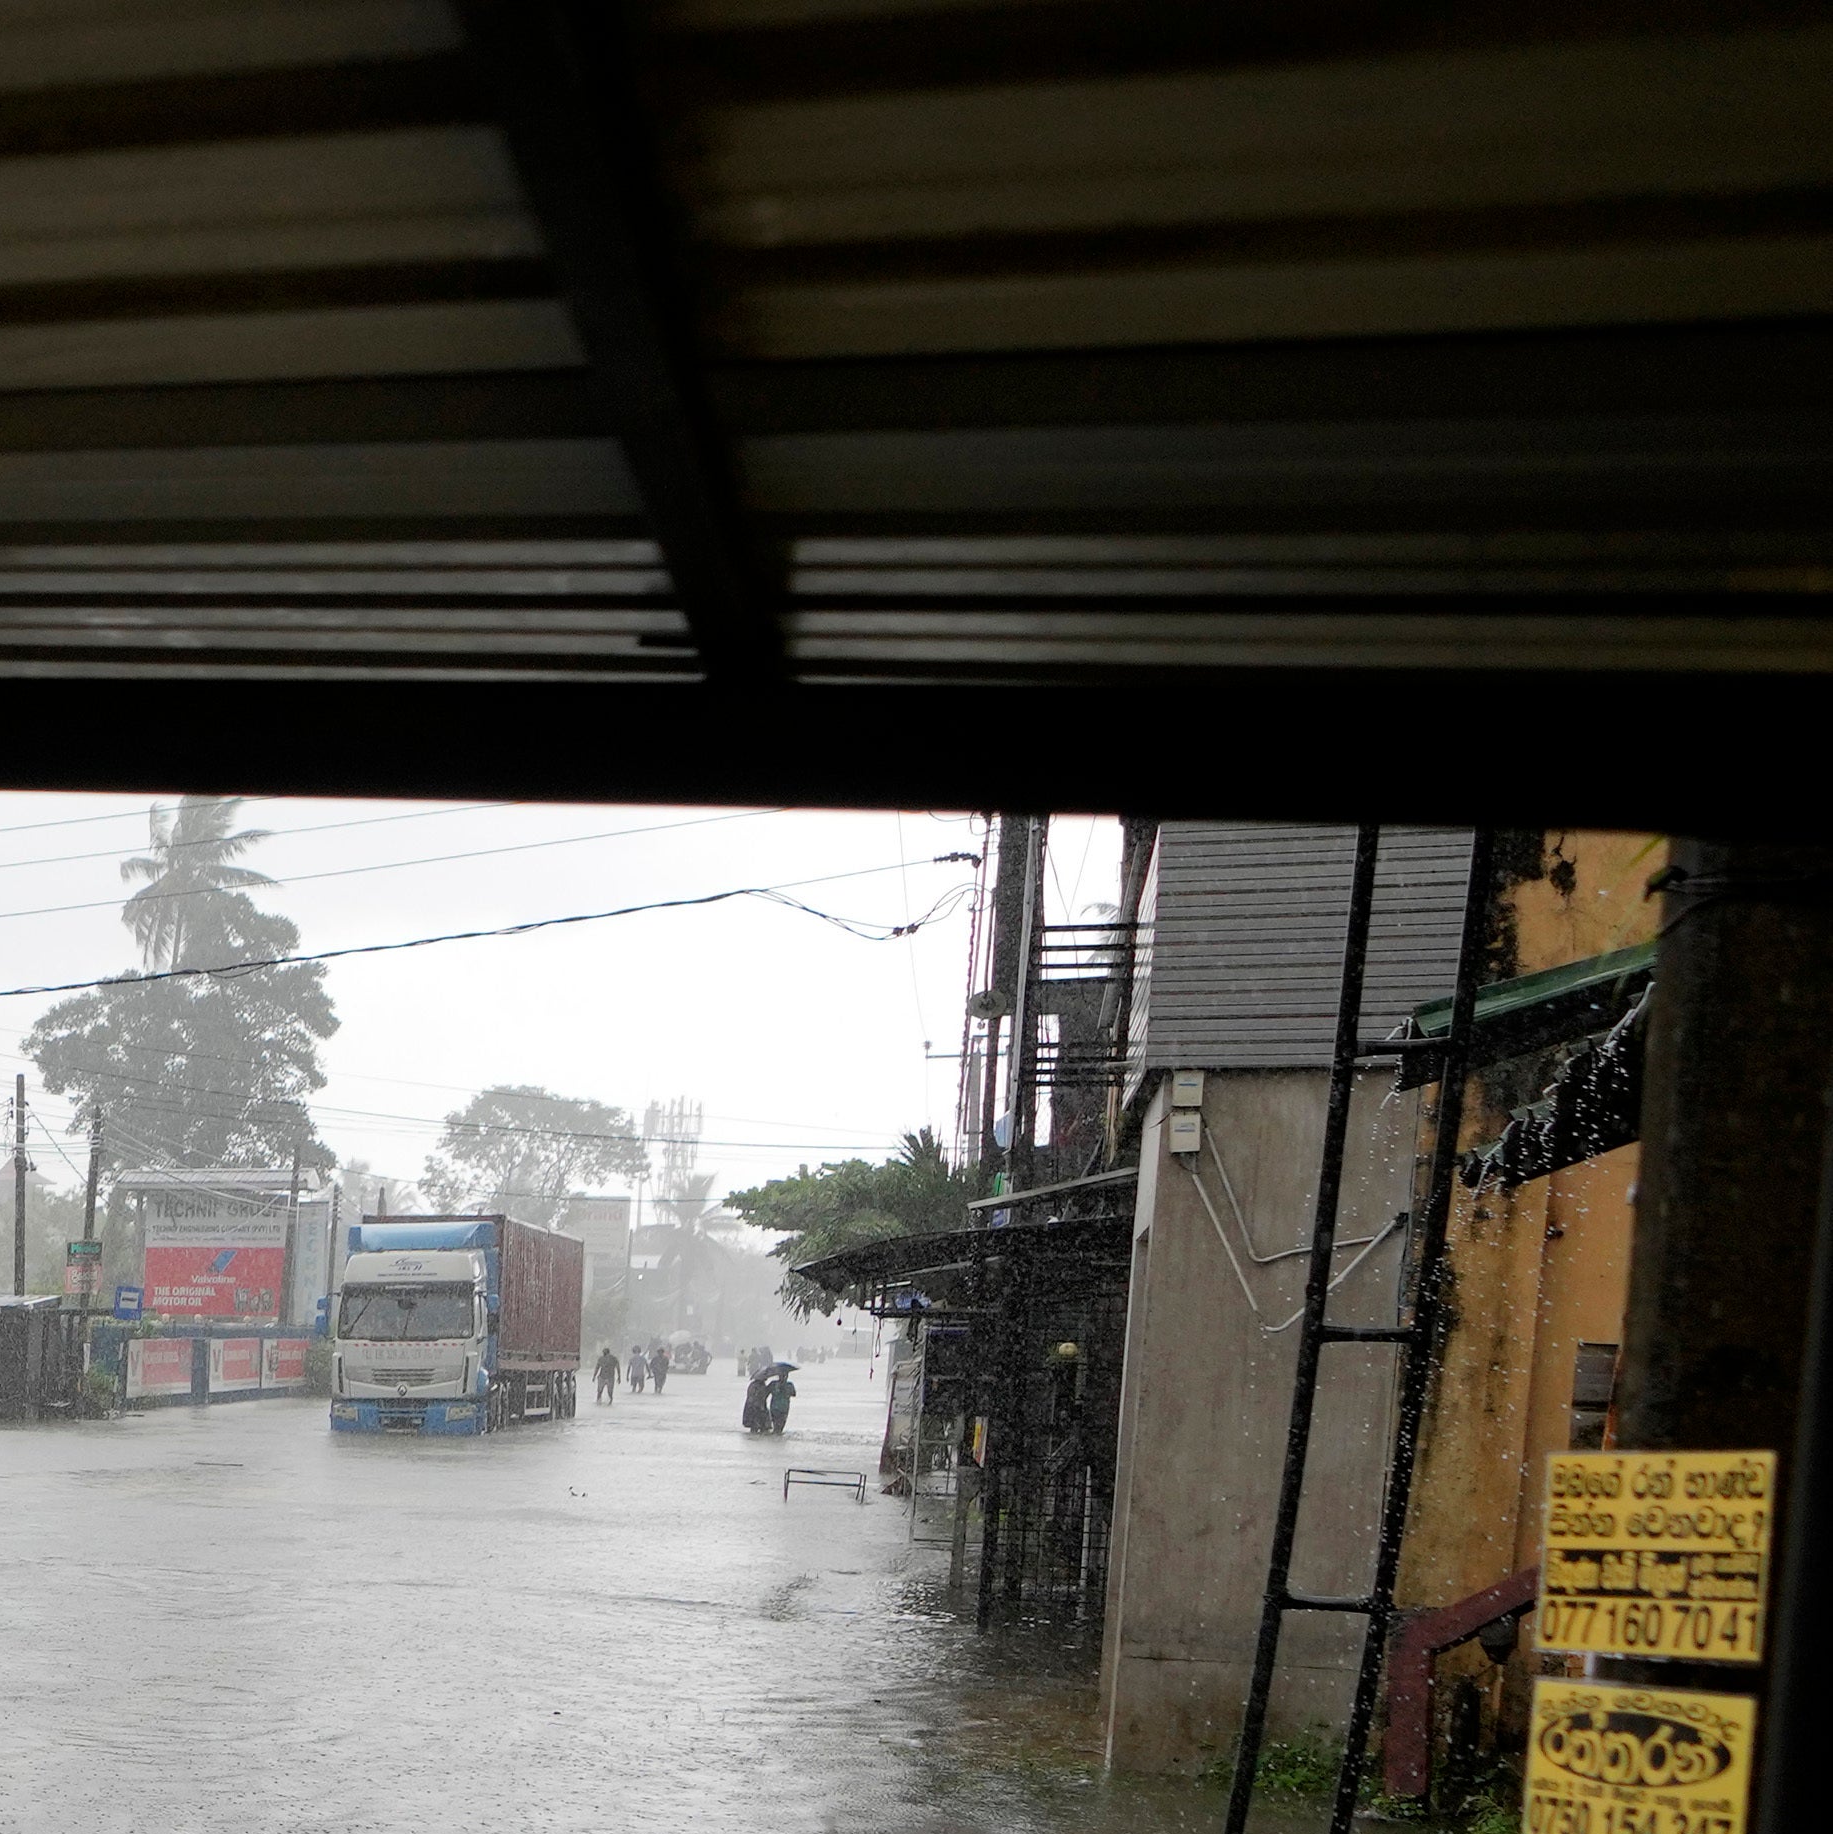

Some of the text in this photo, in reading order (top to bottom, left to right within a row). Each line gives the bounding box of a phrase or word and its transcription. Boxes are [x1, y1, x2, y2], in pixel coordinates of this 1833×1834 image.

[191, 1275, 236, 1284] Valvoline
[154, 1286, 215, 1297] THE ORIGINAL
[152, 1296, 202, 1306] MOTOR OIL
[1541, 1600, 1597, 1643] 077
[1607, 1603, 1663, 1647] 160
